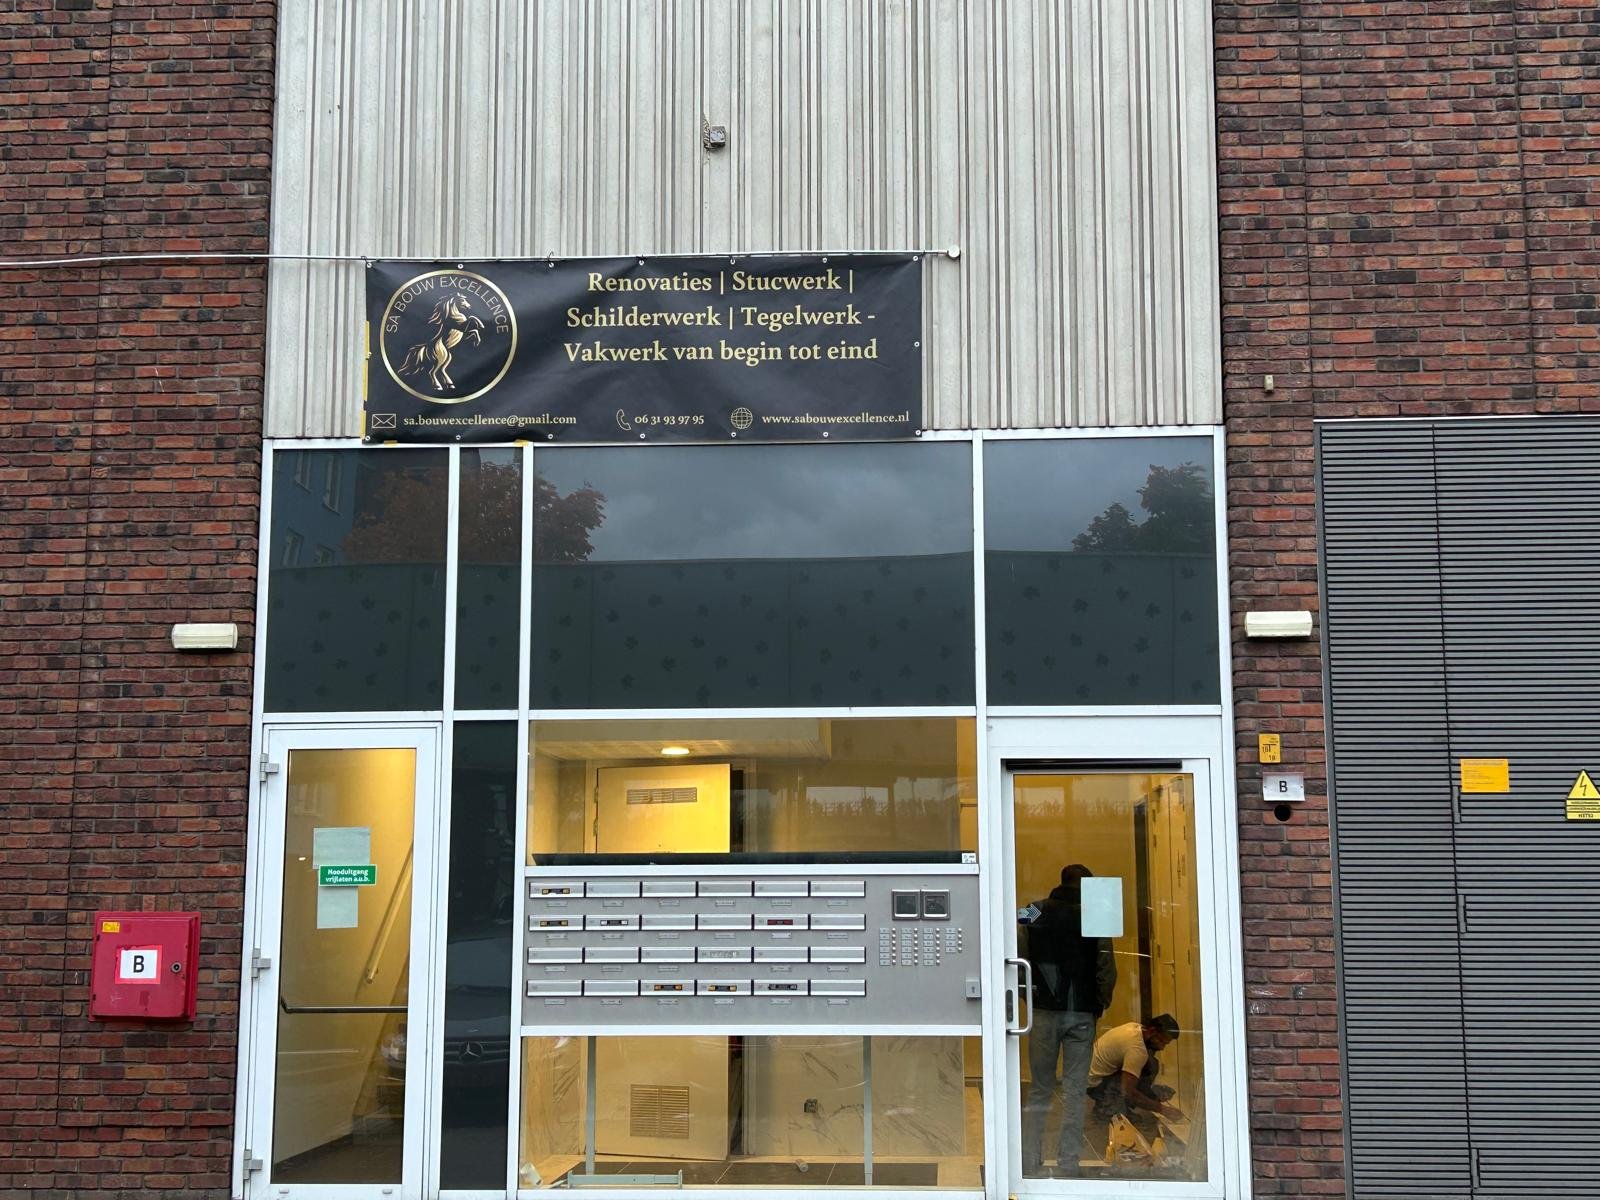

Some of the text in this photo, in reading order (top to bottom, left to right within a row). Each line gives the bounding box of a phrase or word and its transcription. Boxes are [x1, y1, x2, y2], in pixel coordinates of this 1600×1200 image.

[587, 272, 712, 292] Renovaties
[732, 268, 842, 291] Stucwerk
[386, 276, 509, 333] SA BOUW EXCELLENCE
[567, 306, 722, 327] Schilderwerk
[740, 304, 862, 332] Tegelwerk
[564, 338, 878, 367] Vakwerk van begin tot eind
[403, 414, 577, 427] sa.bouwexcellence@gmail.com
[634, 414, 705, 426] 06 31 93 97 95
[762, 410, 910, 424] www.sabouwexcellence.nl
[1279, 780, 1288, 793] B
[325, 875, 352, 883] vrijlaten
[327, 868, 369, 876] Nooduitgang
[133, 955, 145, 973] B
